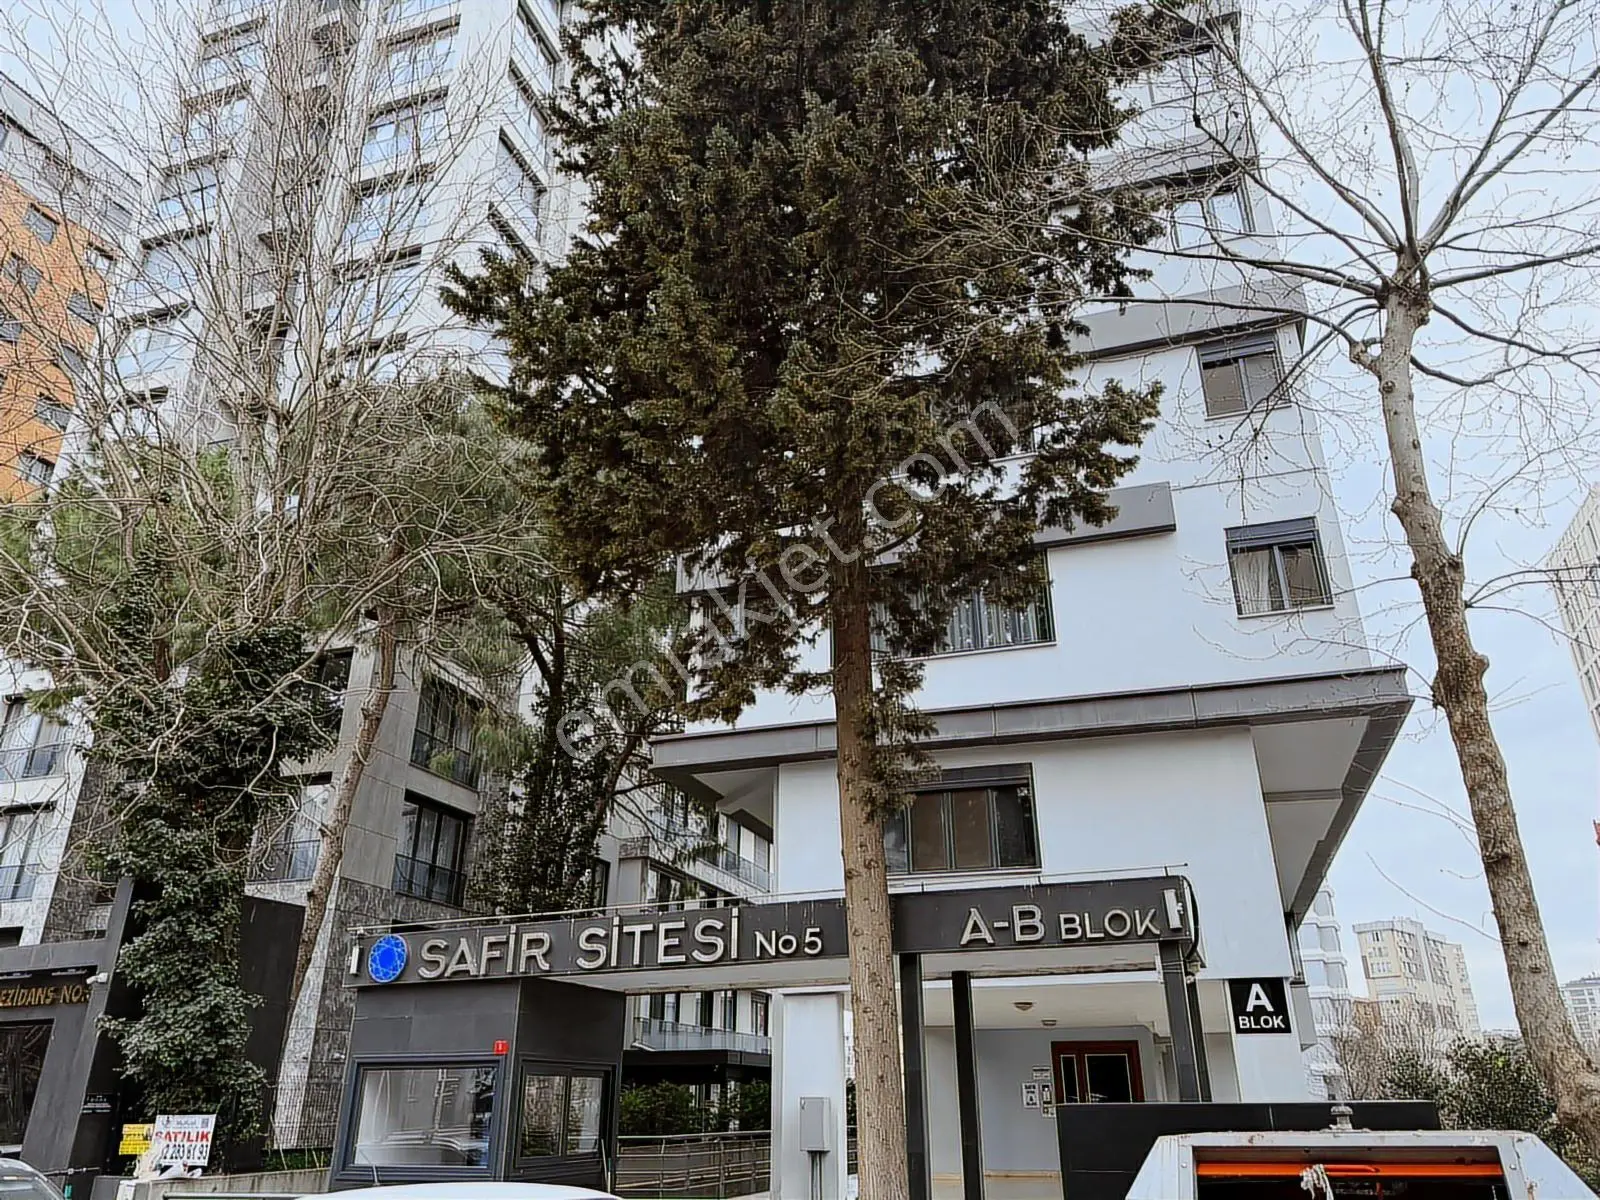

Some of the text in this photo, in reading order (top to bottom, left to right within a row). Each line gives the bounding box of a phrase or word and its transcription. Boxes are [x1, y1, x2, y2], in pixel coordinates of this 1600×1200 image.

[960, 904, 1161, 946] A-B BLOK
[417, 923, 551, 980] SAFİR
[576, 906, 740, 972] SİTESİ
[1246, 983, 1274, 1012] A
[1238, 1015, 1285, 1029] BLOK
